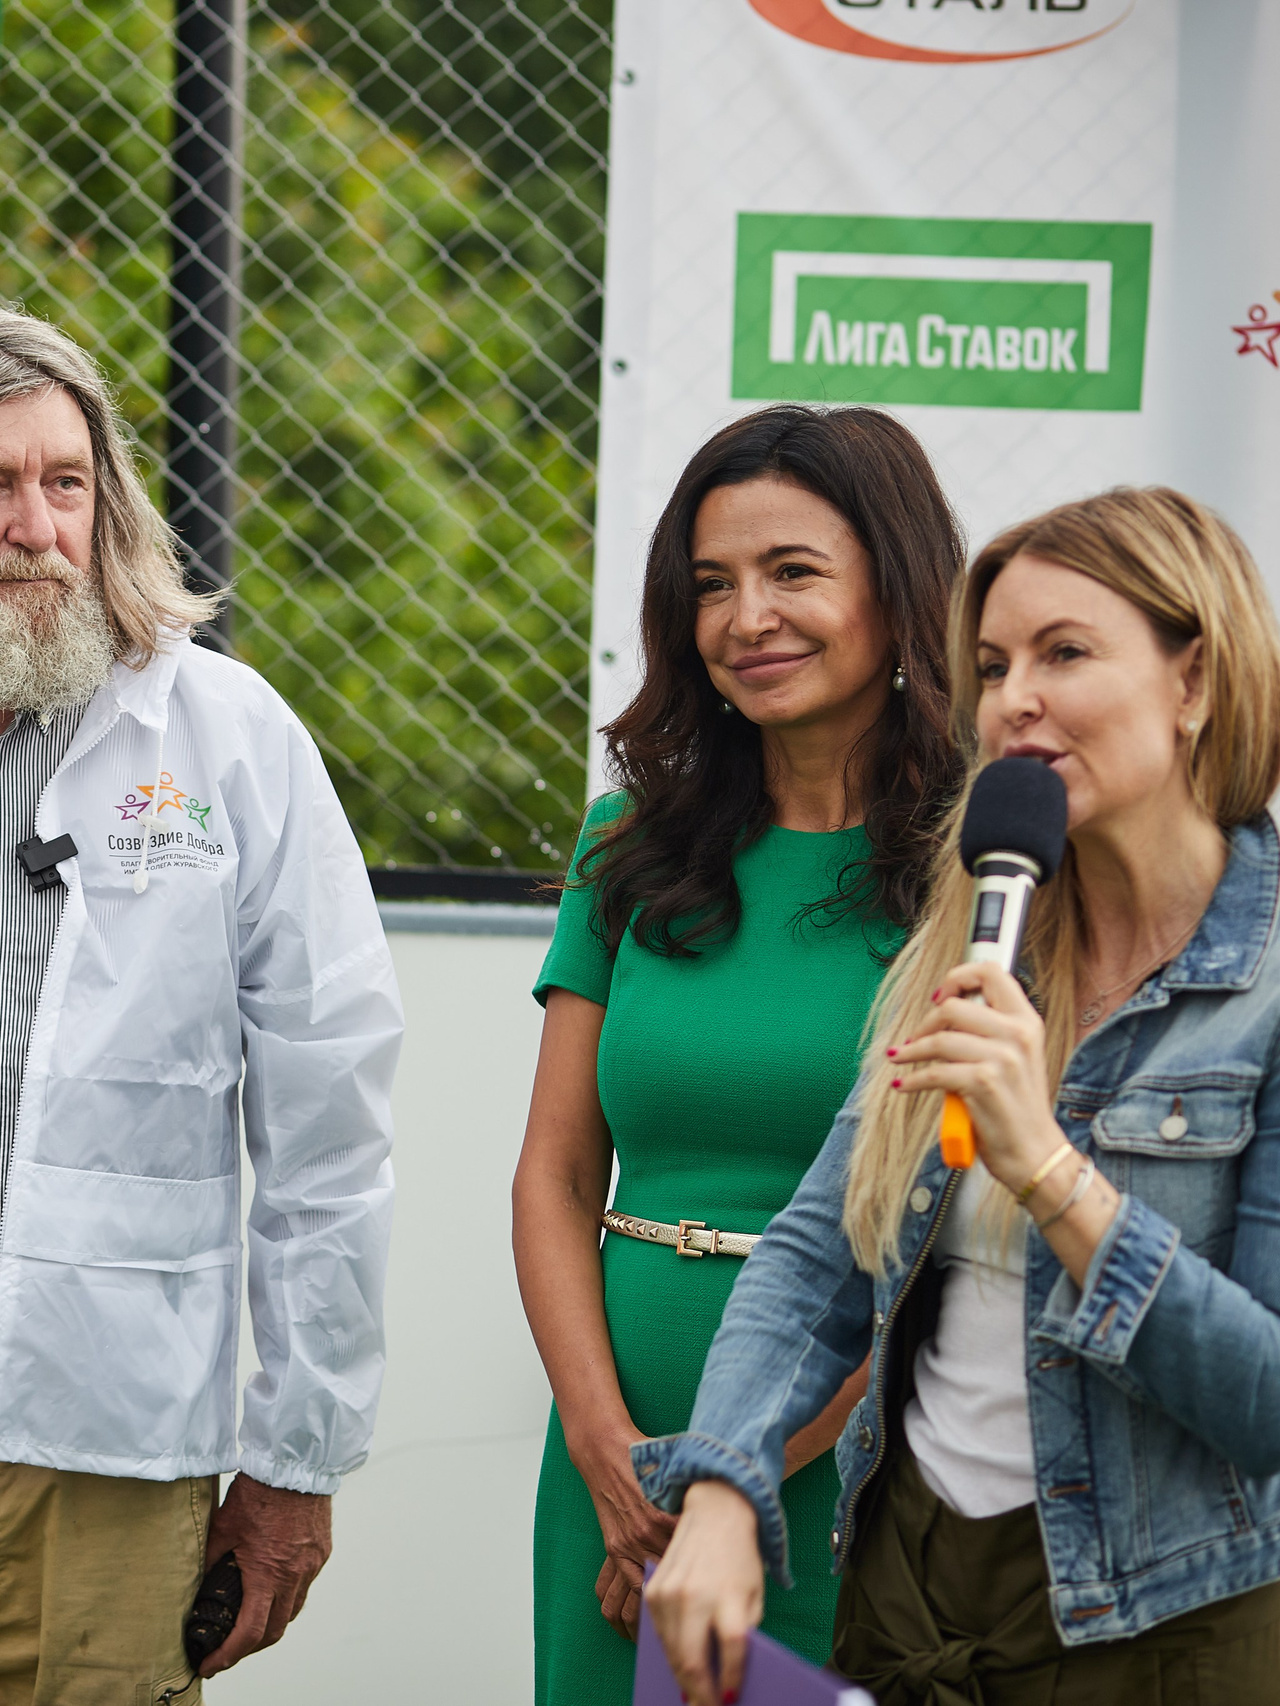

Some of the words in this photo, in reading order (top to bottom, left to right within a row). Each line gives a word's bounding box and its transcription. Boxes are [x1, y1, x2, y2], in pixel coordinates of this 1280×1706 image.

[107, 831, 183, 851] Созвздие
[187, 831, 225, 856] Добра
[120, 853, 198, 867] БЛАГВОРИТЕЛЬНЫЙ
[150, 861, 172, 871] ОЛЕГА
